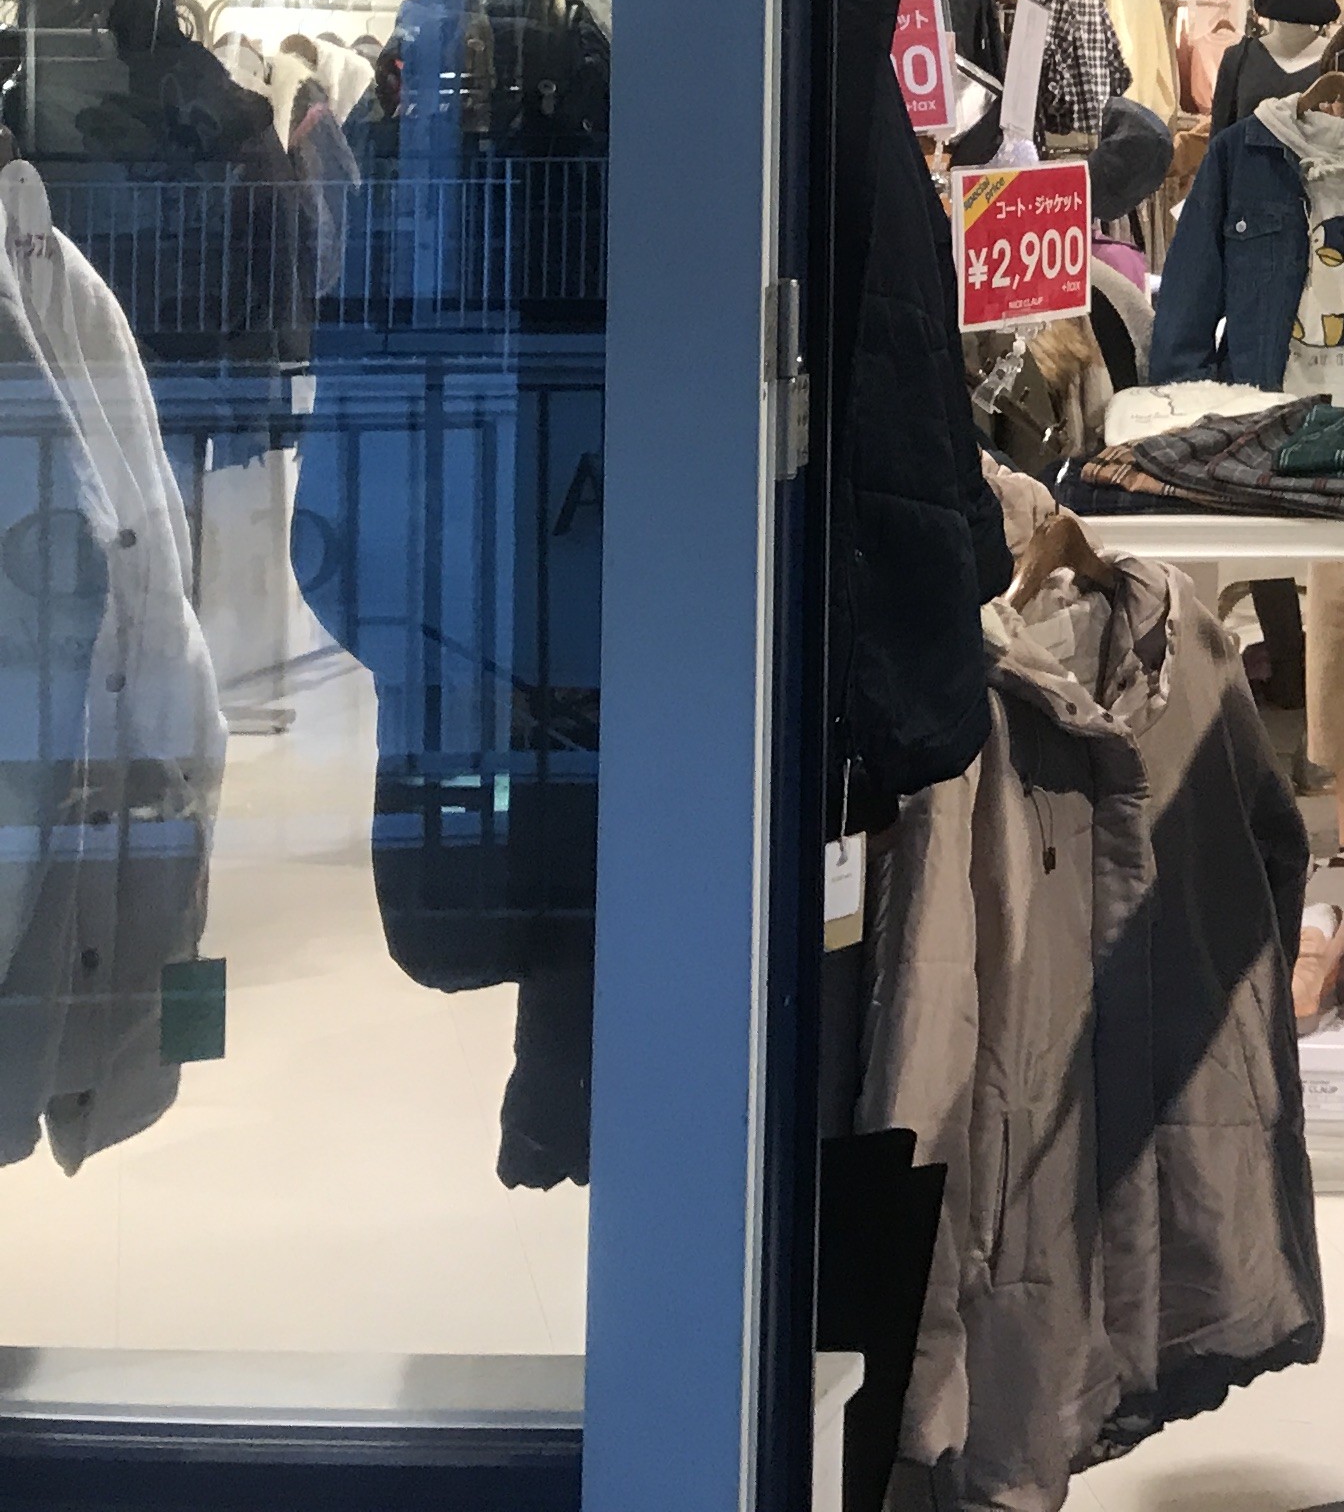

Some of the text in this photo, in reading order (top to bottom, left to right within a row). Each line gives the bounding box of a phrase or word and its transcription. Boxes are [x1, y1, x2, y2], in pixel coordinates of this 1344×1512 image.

[996, 191, 1083, 219] コート・ジャケット
[968, 225, 1084, 290] ¥2,900
